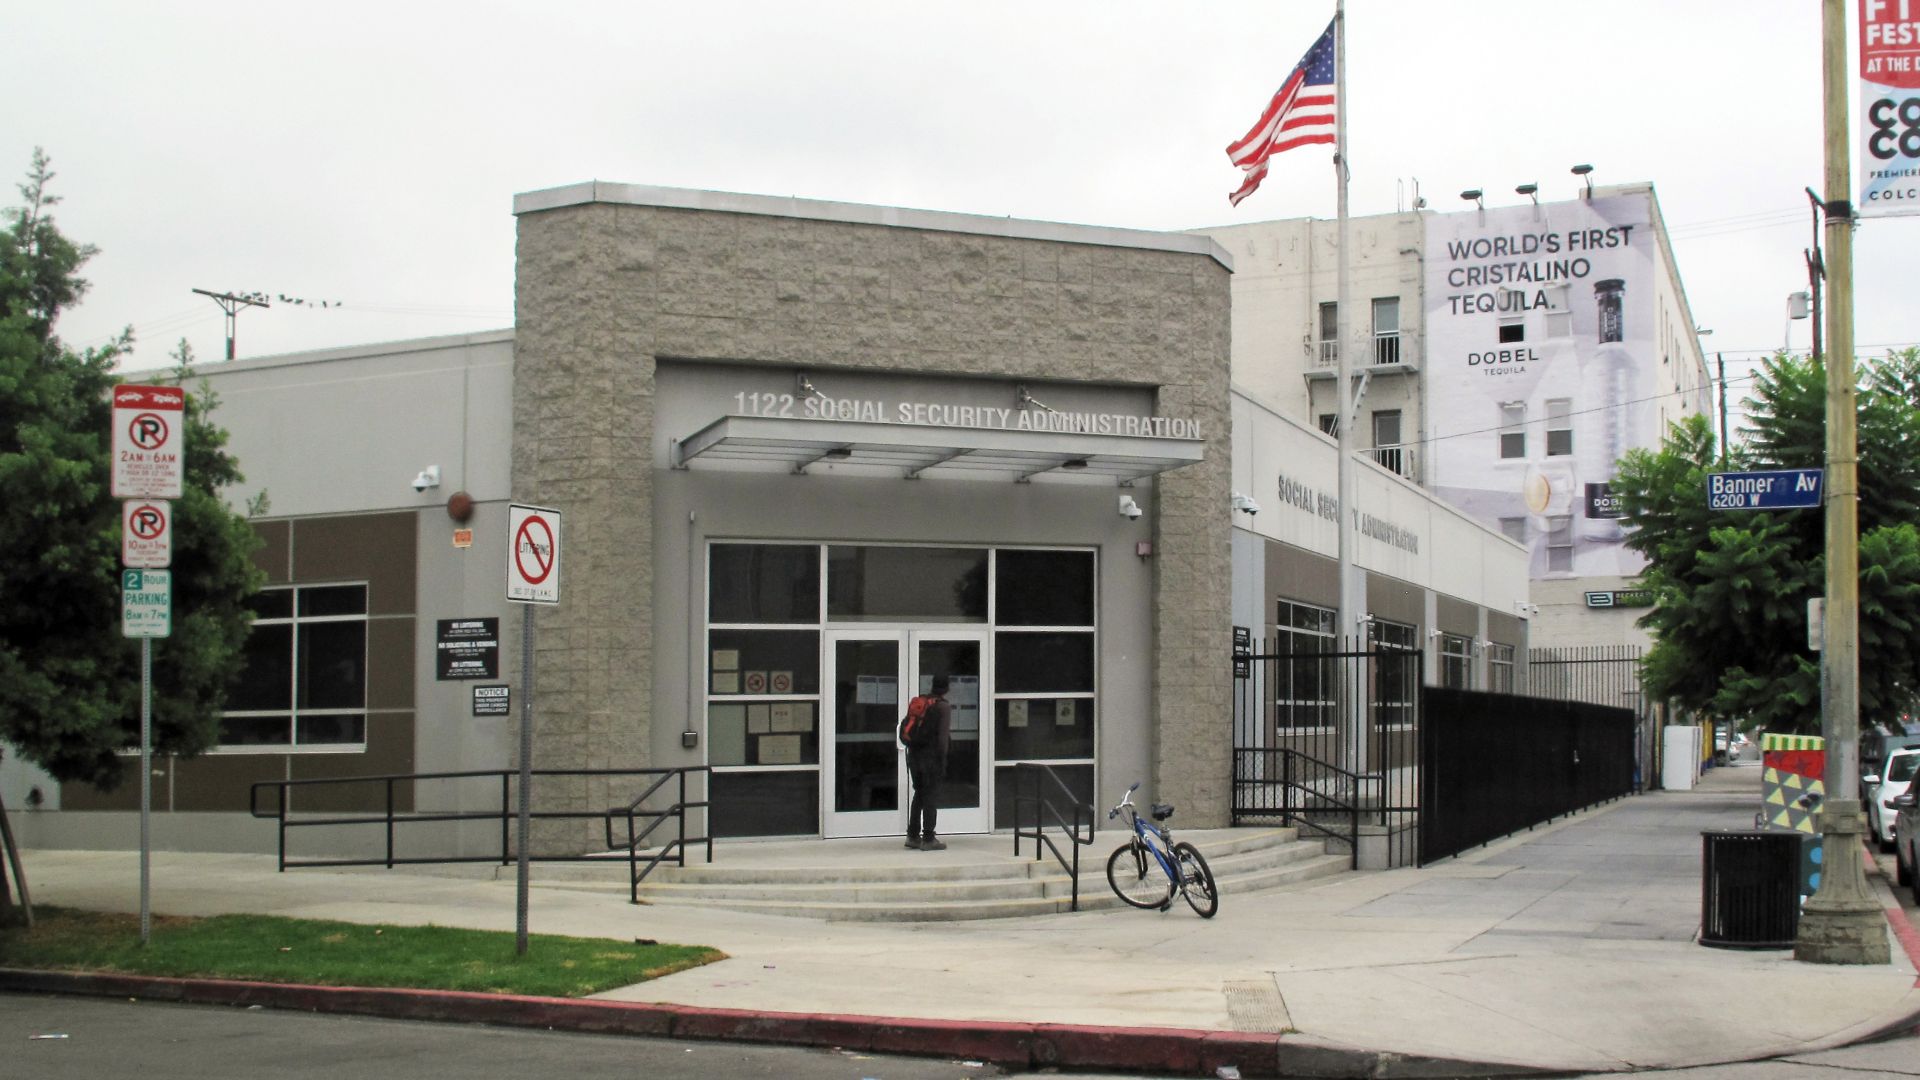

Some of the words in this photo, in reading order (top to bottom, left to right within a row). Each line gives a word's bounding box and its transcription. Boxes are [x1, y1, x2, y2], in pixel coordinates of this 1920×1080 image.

[1867, 57, 1883, 73] AT
[1886, 56, 1911, 71] THE
[1870, 168, 1920, 179] PREMIER
[1448, 233, 1560, 261] WORLD'S
[1568, 226, 1634, 252] FIRST
[1448, 258, 1590, 288] CRISTALINO
[1447, 289, 1556, 315] TEQUILA.
[1468, 348, 1539, 366] DOBEL
[1484, 366, 1526, 376] TEQUILA
[735, 391, 794, 417] 1122
[804, 397, 889, 423] SOCIAL
[898, 403, 1010, 428] SECURITY
[1017, 410, 1200, 438] ADMINISTRATION
[120, 450, 144, 462] 2AM
[153, 452, 176, 464] 6AM
[1712, 475, 1775, 495] Banner
[1795, 472, 1817, 492] Av
[1712, 494, 1745, 508] 6200
[1749, 494, 1760, 506] W
[1278, 475, 1315, 514] SOCIAL
[1361, 513, 1418, 555] ADMINISTRATION
[127, 572, 138, 588] 2
[143, 574, 167, 585] HOUR
[125, 592, 167, 606] PARKING
[126, 609, 142, 620] 8AM
[151, 609, 168, 619] 7PM
[478, 687, 505, 696] NOTICE
